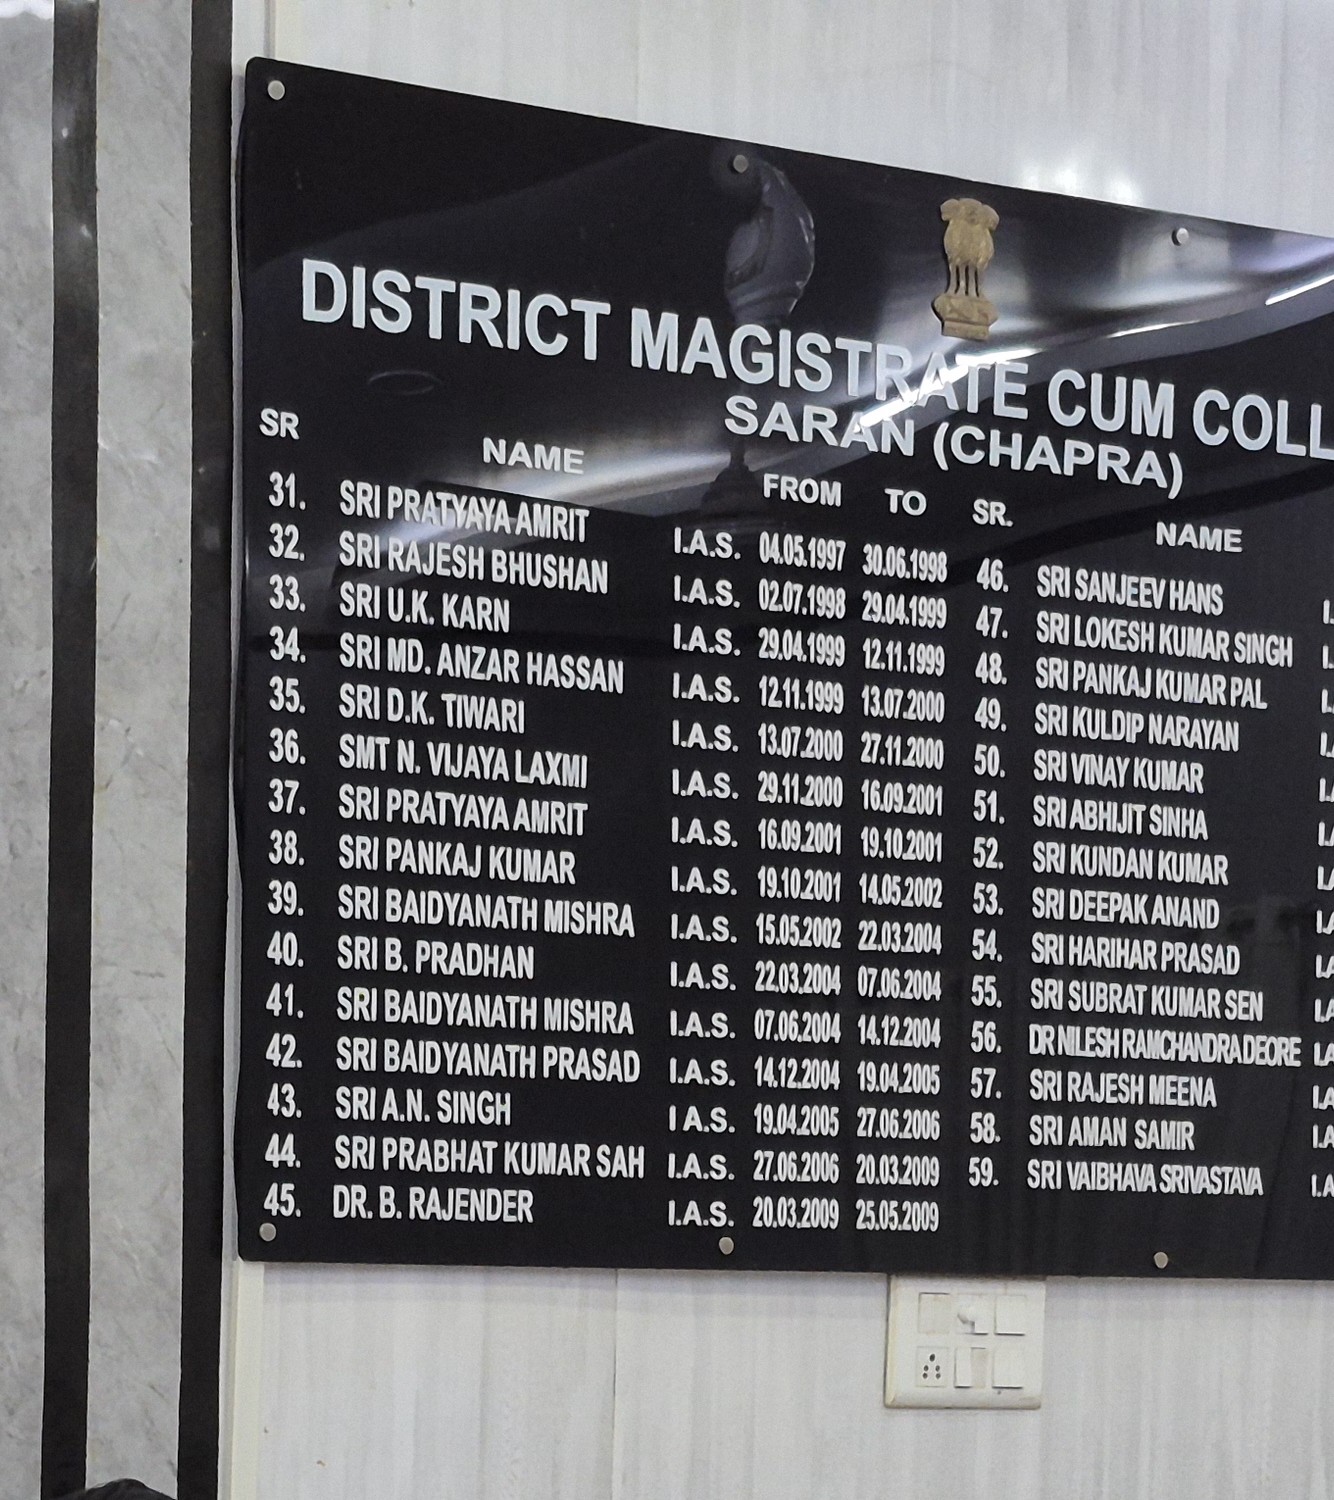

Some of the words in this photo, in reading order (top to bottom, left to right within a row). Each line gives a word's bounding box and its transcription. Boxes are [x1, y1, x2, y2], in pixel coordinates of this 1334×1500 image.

[302, 258, 611, 361] DISTRICT
[630, 307, 1030, 420] MAGISTRATE
[1046, 367, 1176, 441] CUM
[258, 407, 301, 441] SR
[482, 437, 585, 475] NAME
[763, 472, 843, 508] FROM
[883, 487, 928, 517] TO
[724, 395, 915, 458] SARAN
[933, 421, 1185, 500] (CHAPRA)
[268, 470, 307, 512] 31.
[339, 479, 382, 520] SRI
[387, 484, 515, 536] PRATYAYA
[512, 500, 591, 544] AMRIT
[673, 526, 742, 561] I.A.S.
[759, 530, 848, 573] 04.05.1997
[861, 542, 949, 584] 30.06.1998
[971, 497, 1015, 528] SR.
[1155, 520, 1244, 554] NAME
[975, 557, 1010, 594] 46.
[1035, 564, 1072, 600] SRI
[1074, 567, 1168, 611] SANJEEV
[1168, 578, 1225, 617] HANS
[269, 573, 307, 613] 33.
[338, 580, 382, 621] SRI
[387, 586, 436, 627] U.K.
[441, 592, 511, 634] KARN
[672, 622, 742, 658] I.A.S.
[757, 626, 847, 669] 29.04.1999
[861, 637, 946, 678] 12.11.1999
[268, 674, 307, 715] 35.
[338, 681, 382, 722] SRI
[386, 686, 436, 727] D.K.
[440, 692, 526, 735] TIWARI
[671, 718, 740, 754] I.A.S.
[757, 722, 844, 763] 13.07.2000
[859, 730, 945, 772] 27.11.2000
[974, 696, 1008, 733] 49.
[1033, 701, 1069, 738] SRI
[1071, 705, 1146, 745] KULDIP
[1147, 712, 1240, 753] NARAYAN
[973, 743, 1007, 779] 50.
[1032, 748, 1069, 784] SRI
[1070, 751, 1132, 790] VINAY
[1132, 755, 1205, 795] KUMAR
[267, 777, 307, 817] 37.
[337, 782, 381, 822] SRI
[385, 787, 511, 832] PRATYAYA
[512, 797, 590, 837] AMRIT
[671, 816, 739, 849] I.A.S.
[757, 817, 843, 857] 16.09.2001
[860, 825, 944, 864] 19.10.2001
[972, 836, 1005, 871] 52.
[1031, 840, 1067, 876] SRI
[1069, 842, 1155, 881] KUNDAN
[1157, 848, 1230, 887] KUMAR
[267, 879, 305, 918] 39.
[337, 883, 380, 922] SRI
[384, 887, 539, 933] BAIDYANATH
[543, 898, 637, 939] MISHRA
[670, 913, 739, 945] I.A.S.
[755, 912, 843, 950] 15.05.2002
[857, 919, 944, 957] 22.03.2004
[971, 927, 1004, 964] 54.
[1030, 930, 1066, 967] SRI
[1068, 933, 1159, 972] HARIHAR
[1160, 940, 1242, 977] PRASAD
[265, 981, 305, 1020] 41.
[335, 985, 379, 1023] SRI
[383, 987, 539, 1032] BAIDYANATH
[543, 996, 636, 1036] MISHRA
[669, 1009, 737, 1040] I.A.S.
[753, 1007, 843, 1045] 07.06.2004
[857, 1013, 943, 1050] 14.12.2004
[264, 1132, 302, 1170] 44.
[334, 1134, 377, 1172] SRI
[381, 1136, 500, 1176] PRABHAT
[503, 1140, 592, 1178] KUMAR
[595, 1143, 646, 1180] SAH
[667, 1152, 736, 1182] I.A.S.
[752, 1149, 841, 1185] 27.06.2006
[855, 1152, 941, 1188] 20.03.2009
[968, 1156, 1000, 1188] 59.
[1026, 1158, 1063, 1191] SRI
[1065, 1160, 1159, 1194] VAIBHAVA
[1158, 1163, 1265, 1197] SRIVASTAVA
[263, 1181, 303, 1219] 45.
[332, 1183, 375, 1220] DR.
[378, 1184, 403, 1221] B.
[408, 1185, 535, 1224] RAJENDER
[667, 1199, 736, 1229] I.A.S.
[751, 1195, 841, 1231] 20.03.2009
[855, 1198, 941, 1233] 25.05.2009
